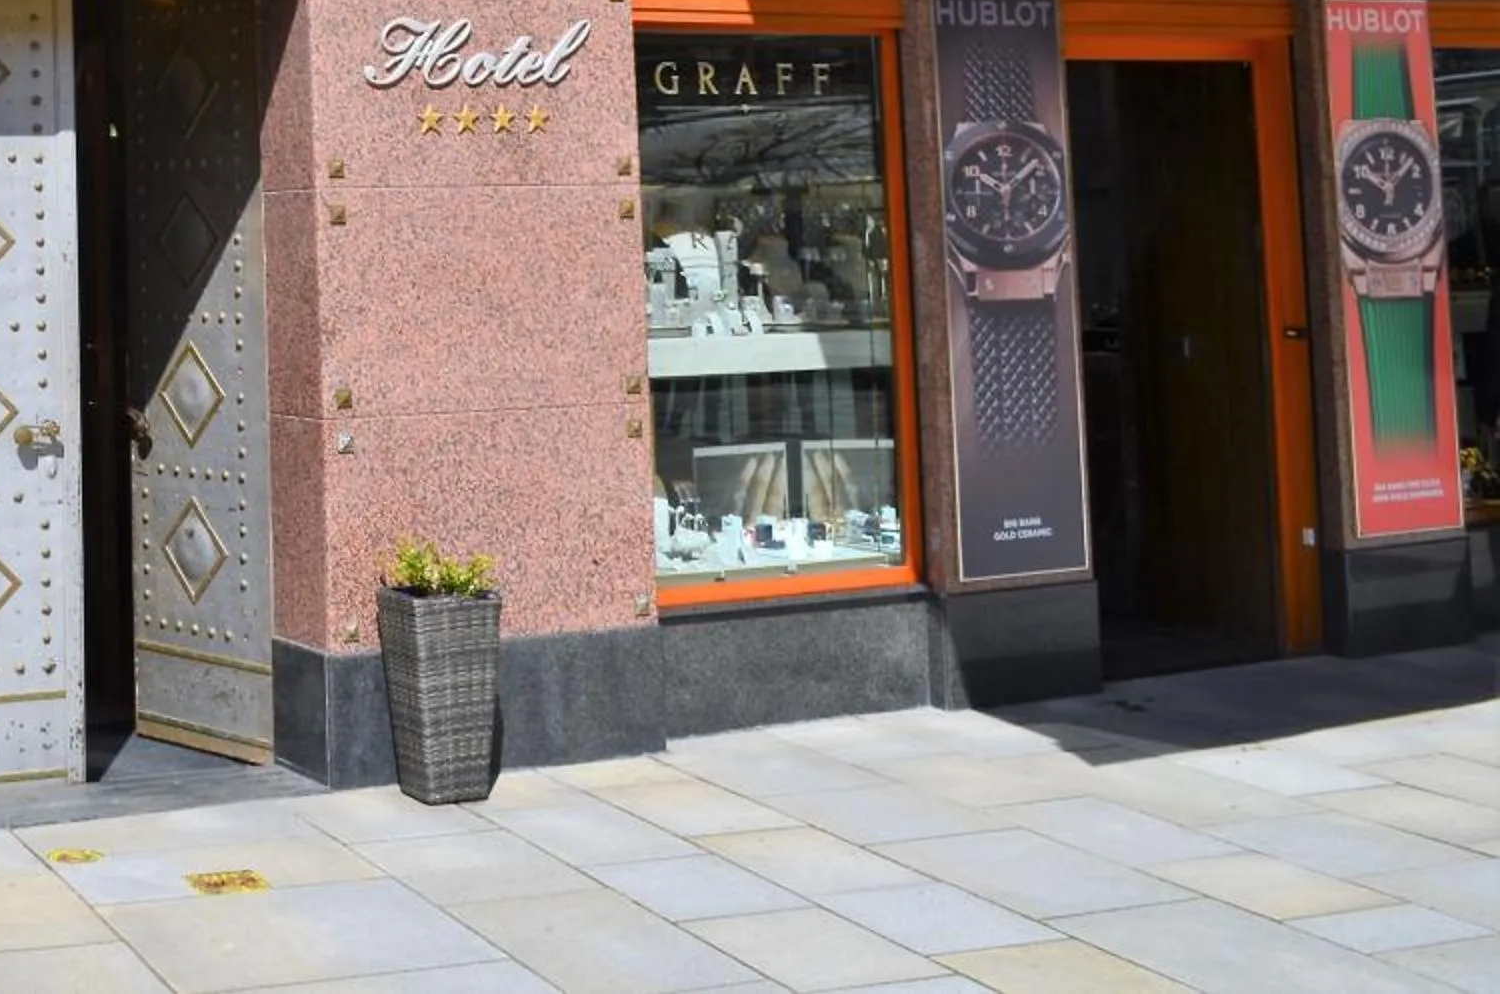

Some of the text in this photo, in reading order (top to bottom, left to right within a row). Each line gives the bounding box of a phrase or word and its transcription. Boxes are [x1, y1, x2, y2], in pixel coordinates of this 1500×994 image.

[1326, 6, 1425, 33] HUBLOT
[364, 17, 591, 86] Hotel
[654, 61, 832, 95] GRAFF
